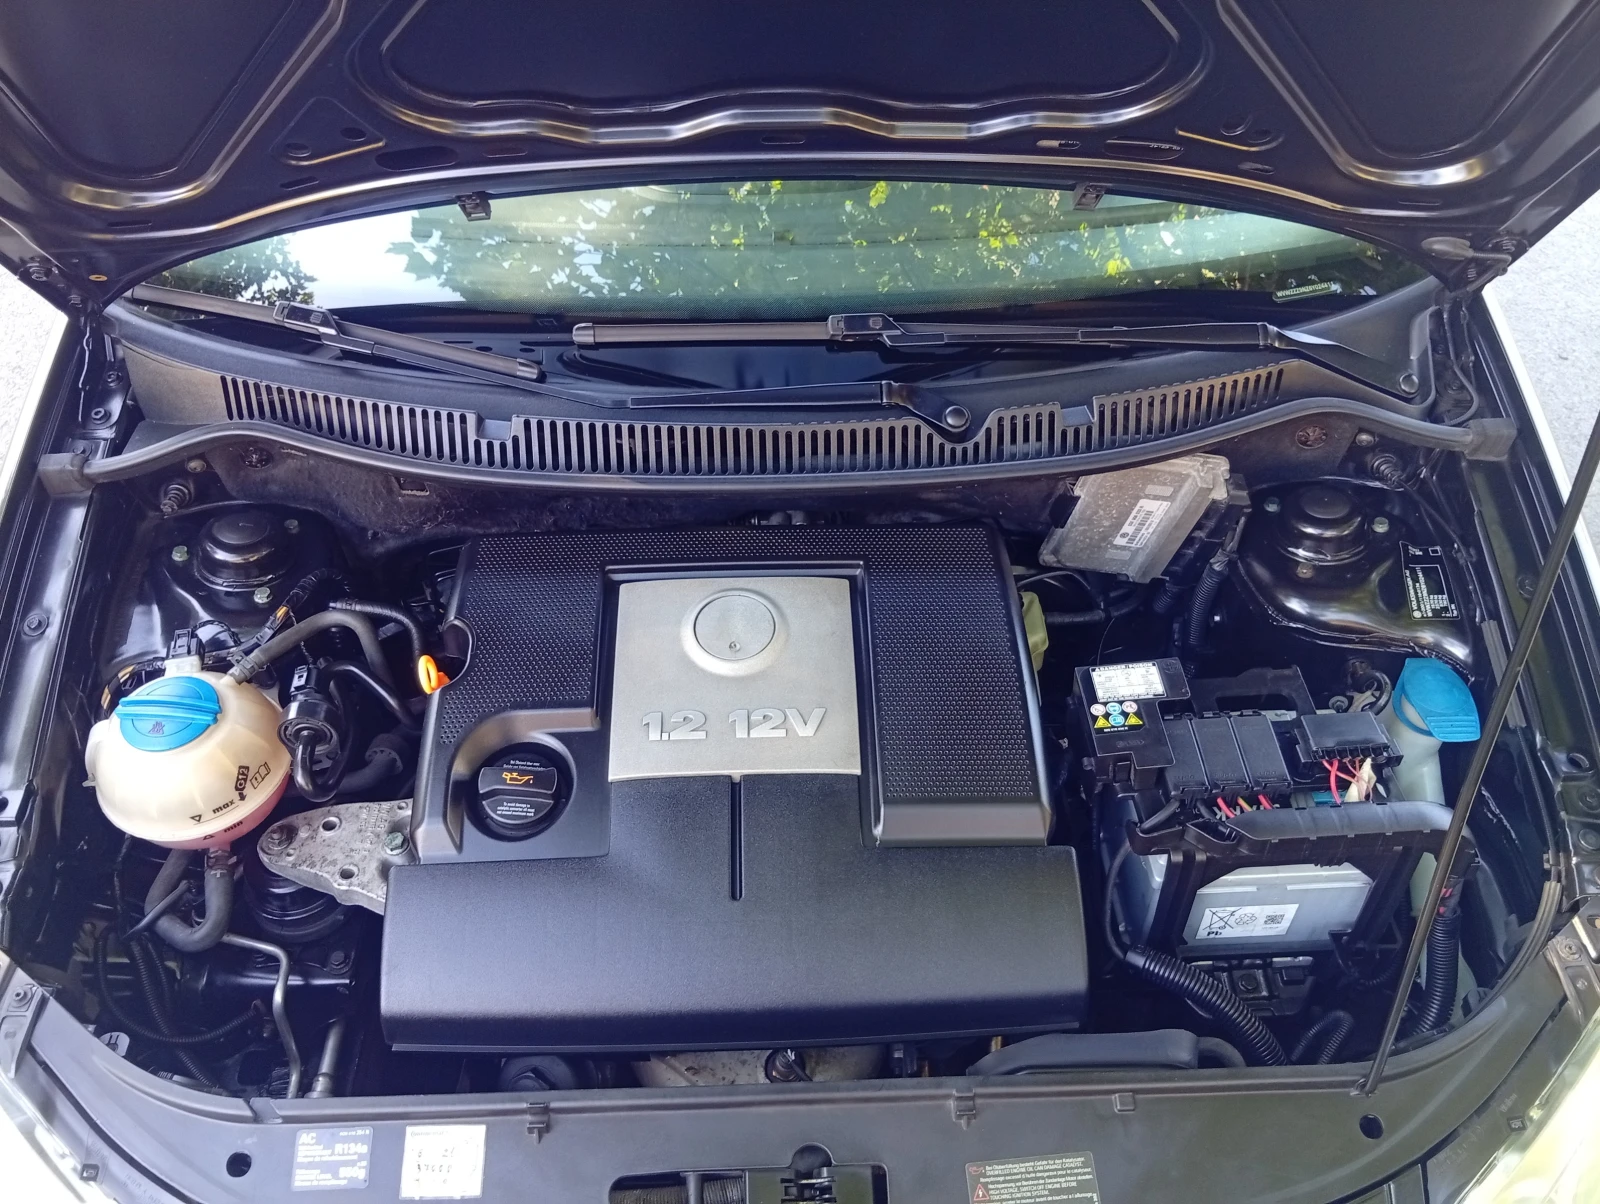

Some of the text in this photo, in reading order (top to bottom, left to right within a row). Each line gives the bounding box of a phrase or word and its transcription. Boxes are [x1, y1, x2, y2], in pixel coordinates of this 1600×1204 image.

[642, 707, 827, 740] 1.2 12V
[236, 768, 248, 788] G12
[212, 800, 235, 814] max
[224, 820, 244, 832] min
[298, 1132, 316, 1144] AC
[334, 1142, 368, 1154] R134a
